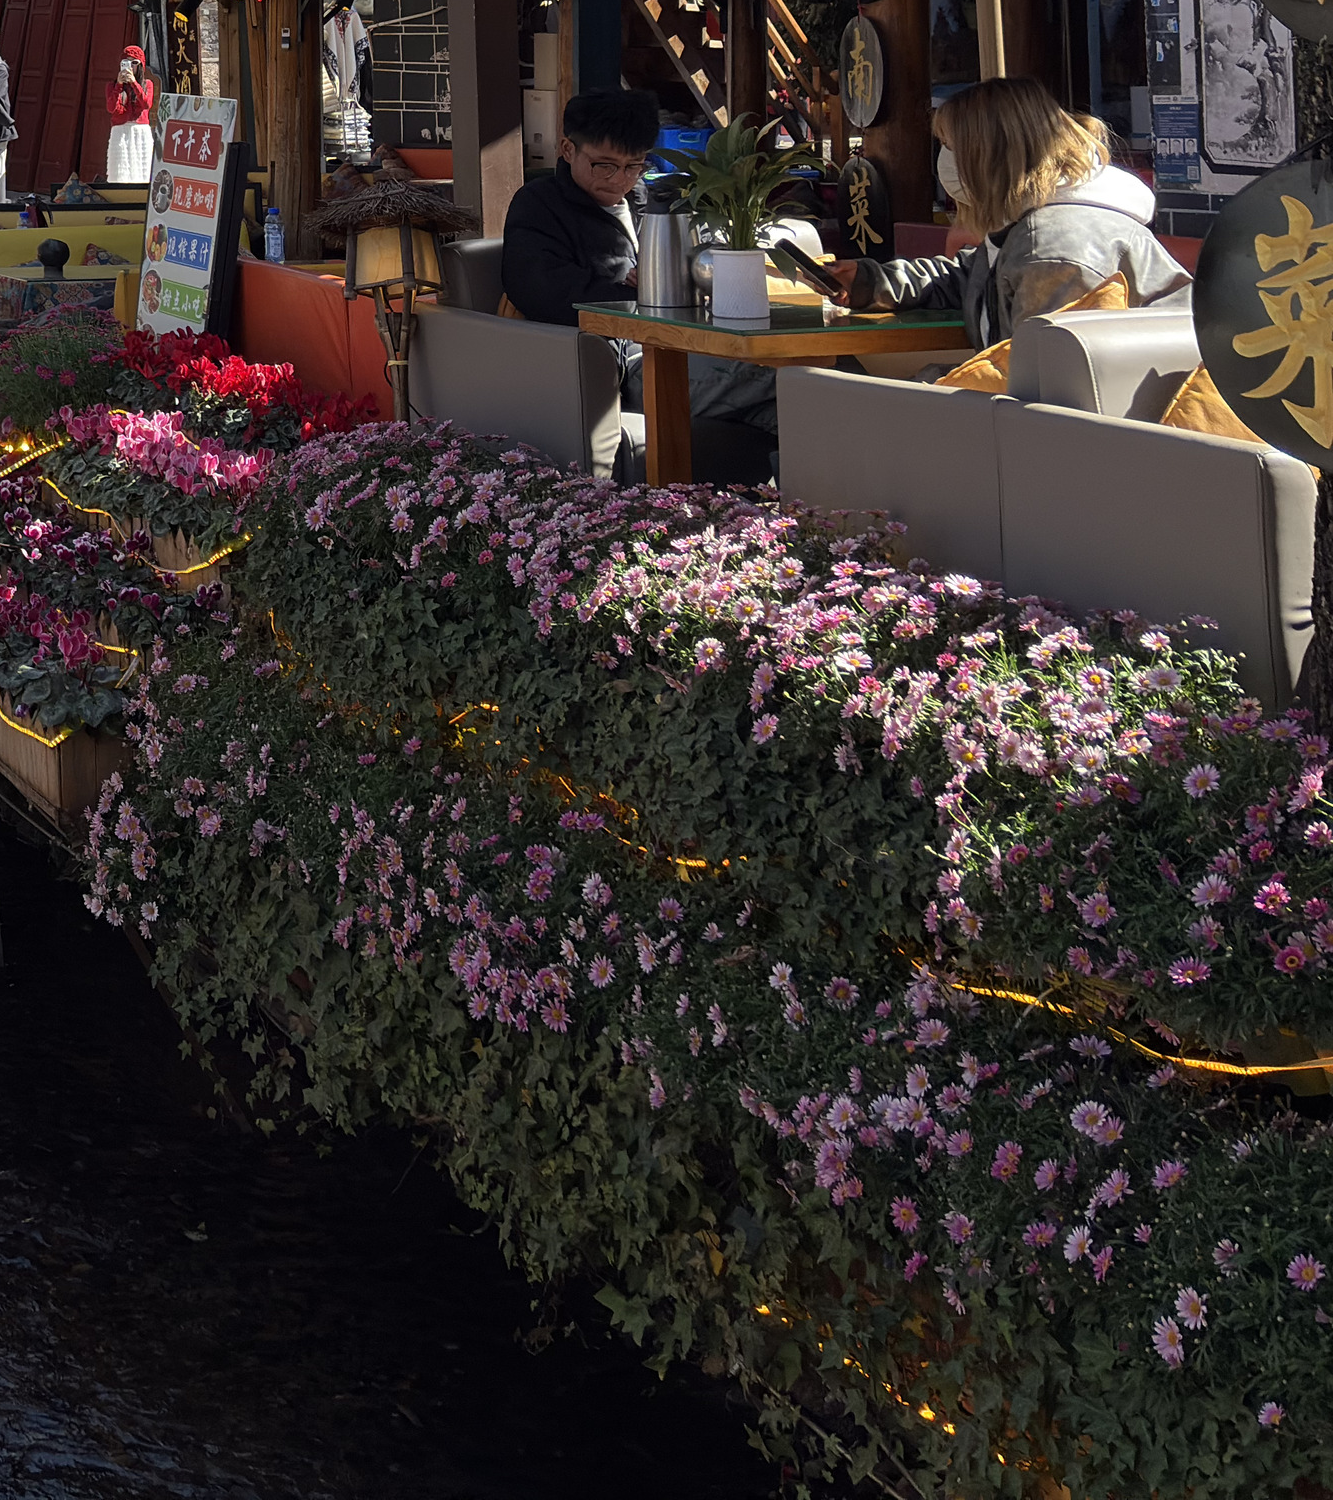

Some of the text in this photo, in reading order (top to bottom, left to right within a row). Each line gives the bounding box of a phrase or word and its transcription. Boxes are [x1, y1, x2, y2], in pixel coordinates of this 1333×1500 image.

[171, 126, 212, 163] 下午茶
[174, 185, 215, 214] 现磨咖啡
[167, 237, 209, 266] 现榨果汁
